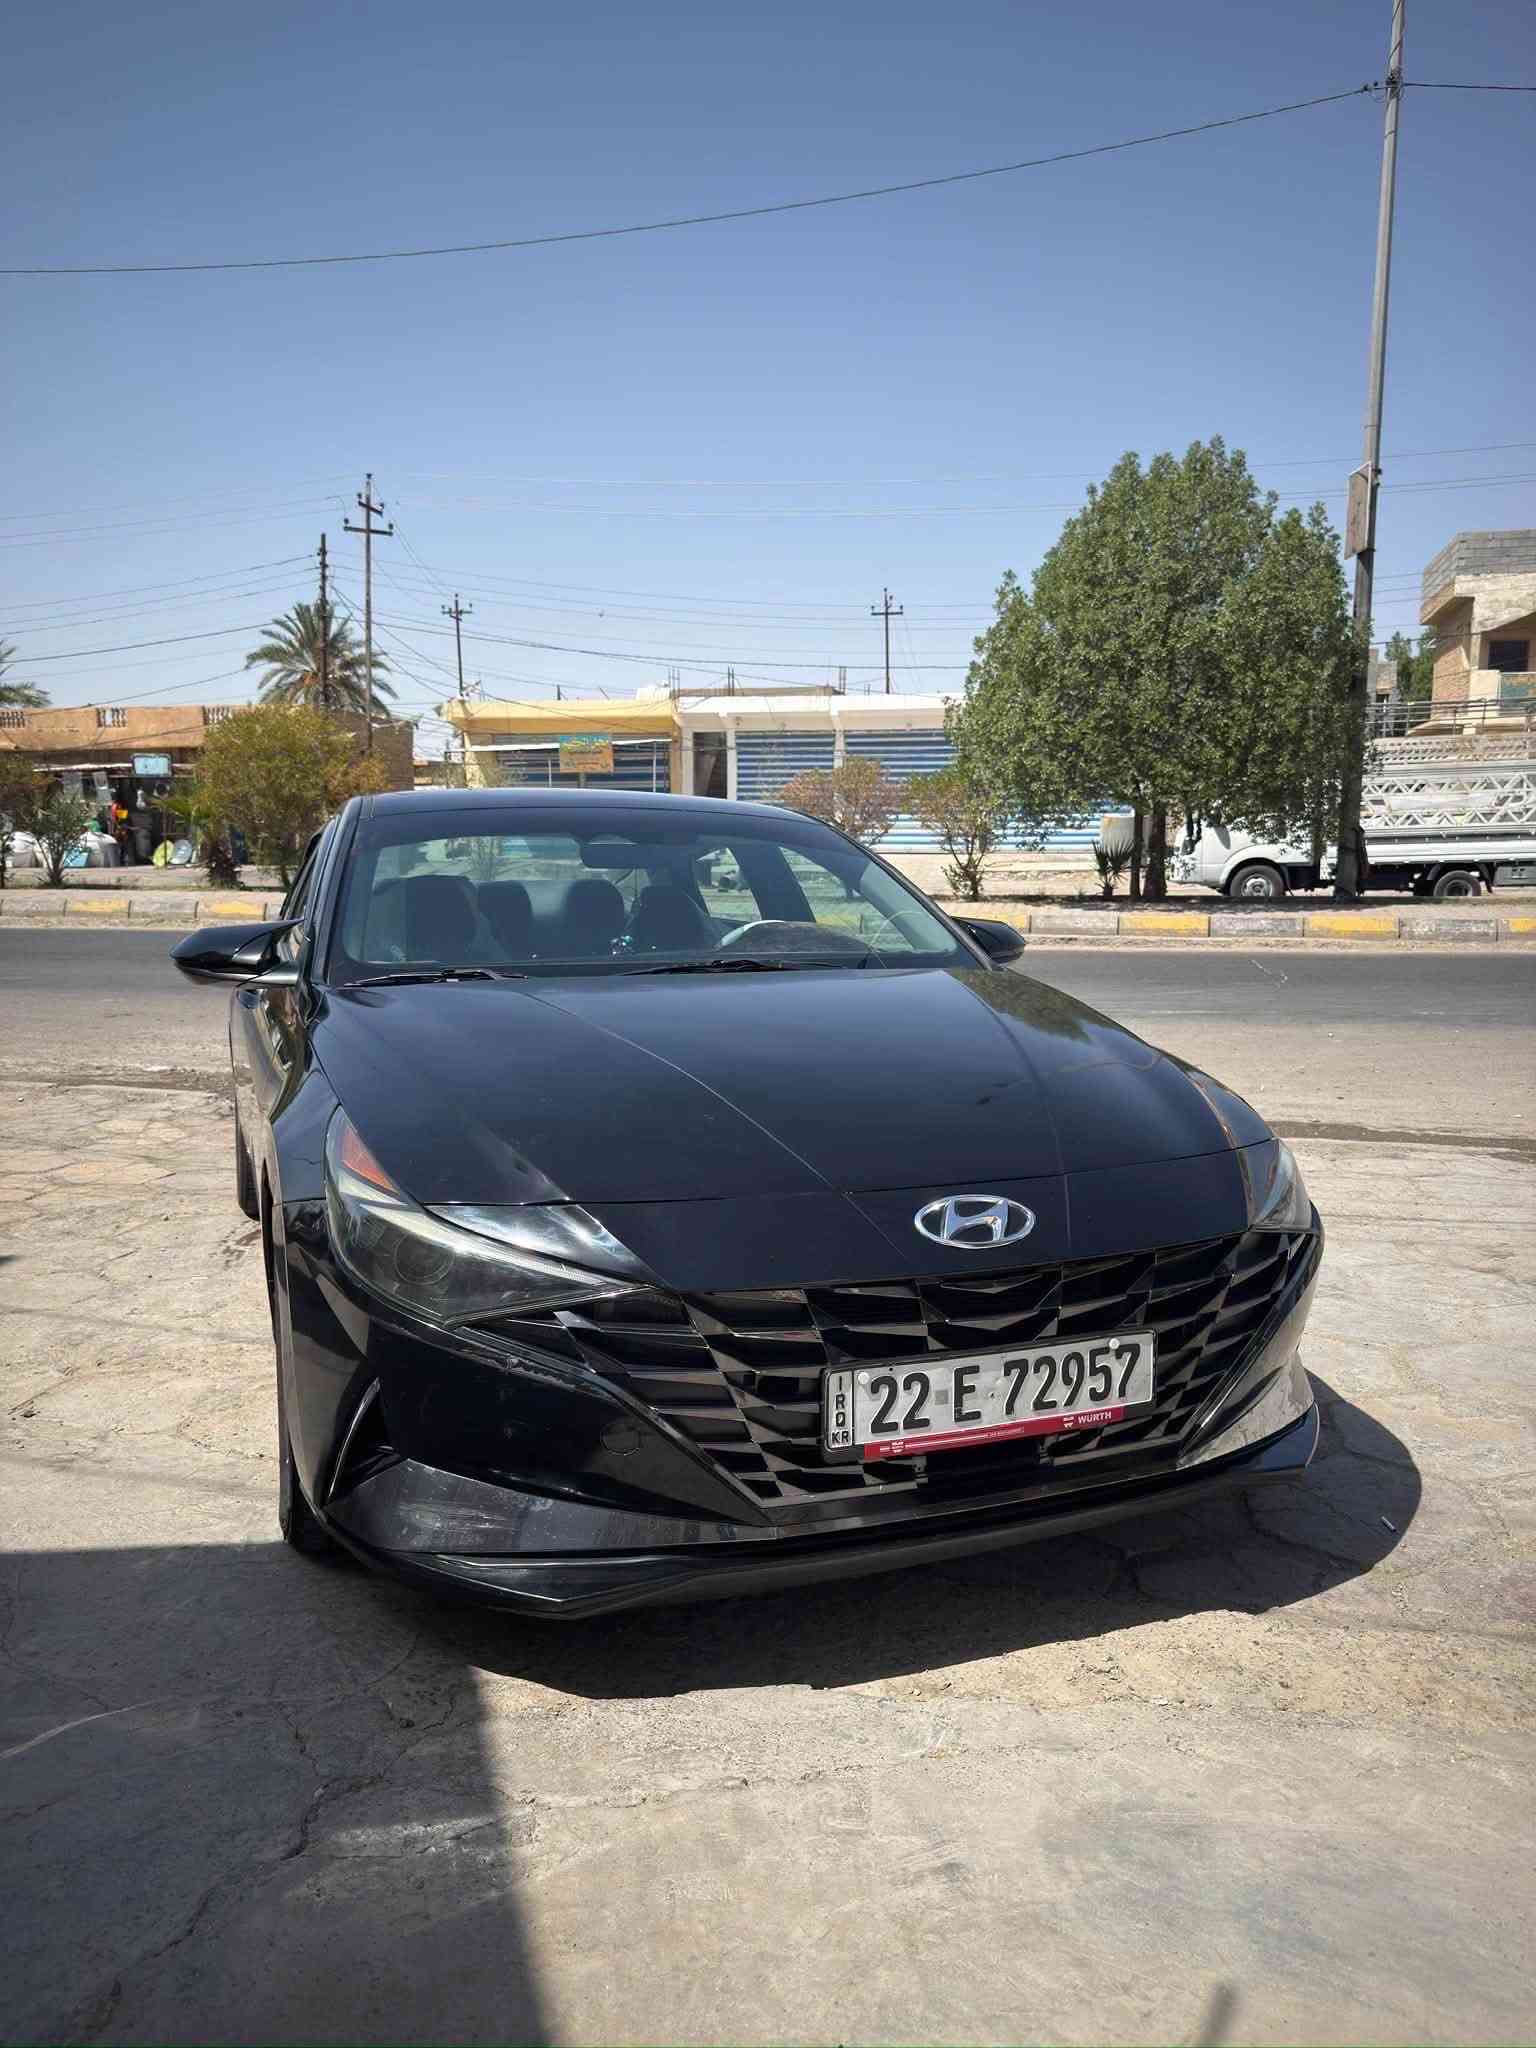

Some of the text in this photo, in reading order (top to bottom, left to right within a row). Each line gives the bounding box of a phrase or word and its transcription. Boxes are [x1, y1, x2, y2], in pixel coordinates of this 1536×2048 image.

[870, 1343, 1141, 1434] 22 E 72957
[831, 1430, 849, 1444] KR
